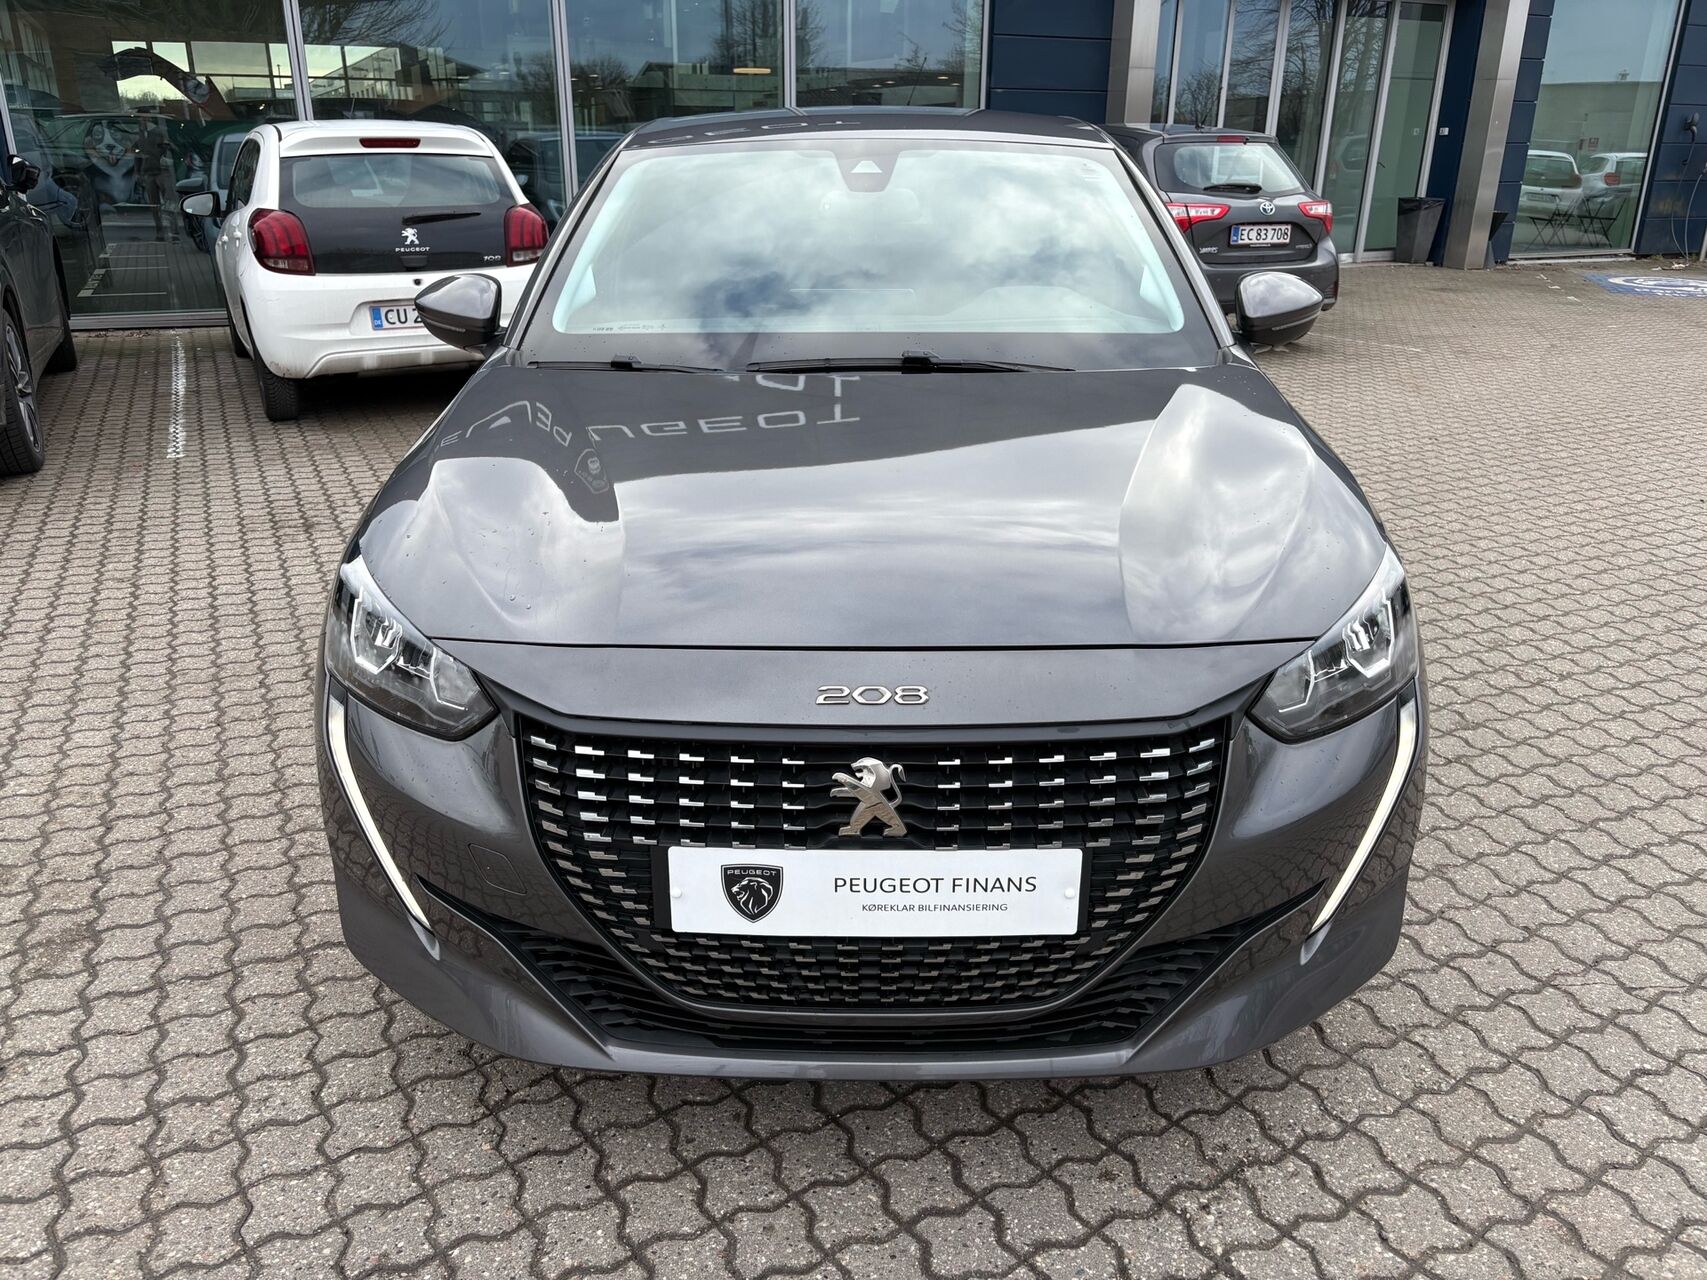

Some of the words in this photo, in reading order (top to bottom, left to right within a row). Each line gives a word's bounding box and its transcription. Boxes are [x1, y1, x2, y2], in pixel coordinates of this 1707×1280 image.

[1240, 228, 1254, 241] EC
[1255, 228, 1269, 241] 83
[1270, 227, 1290, 241] 708
[384, 308, 408, 325] CU
[815, 684, 930, 706] 208
[834, 877, 944, 893] PEUGEOT
[952, 876, 1037, 893] FINANS
[861, 903, 915, 912] KØREKLAR
[917, 903, 1008, 912] BILFINANSIERING
